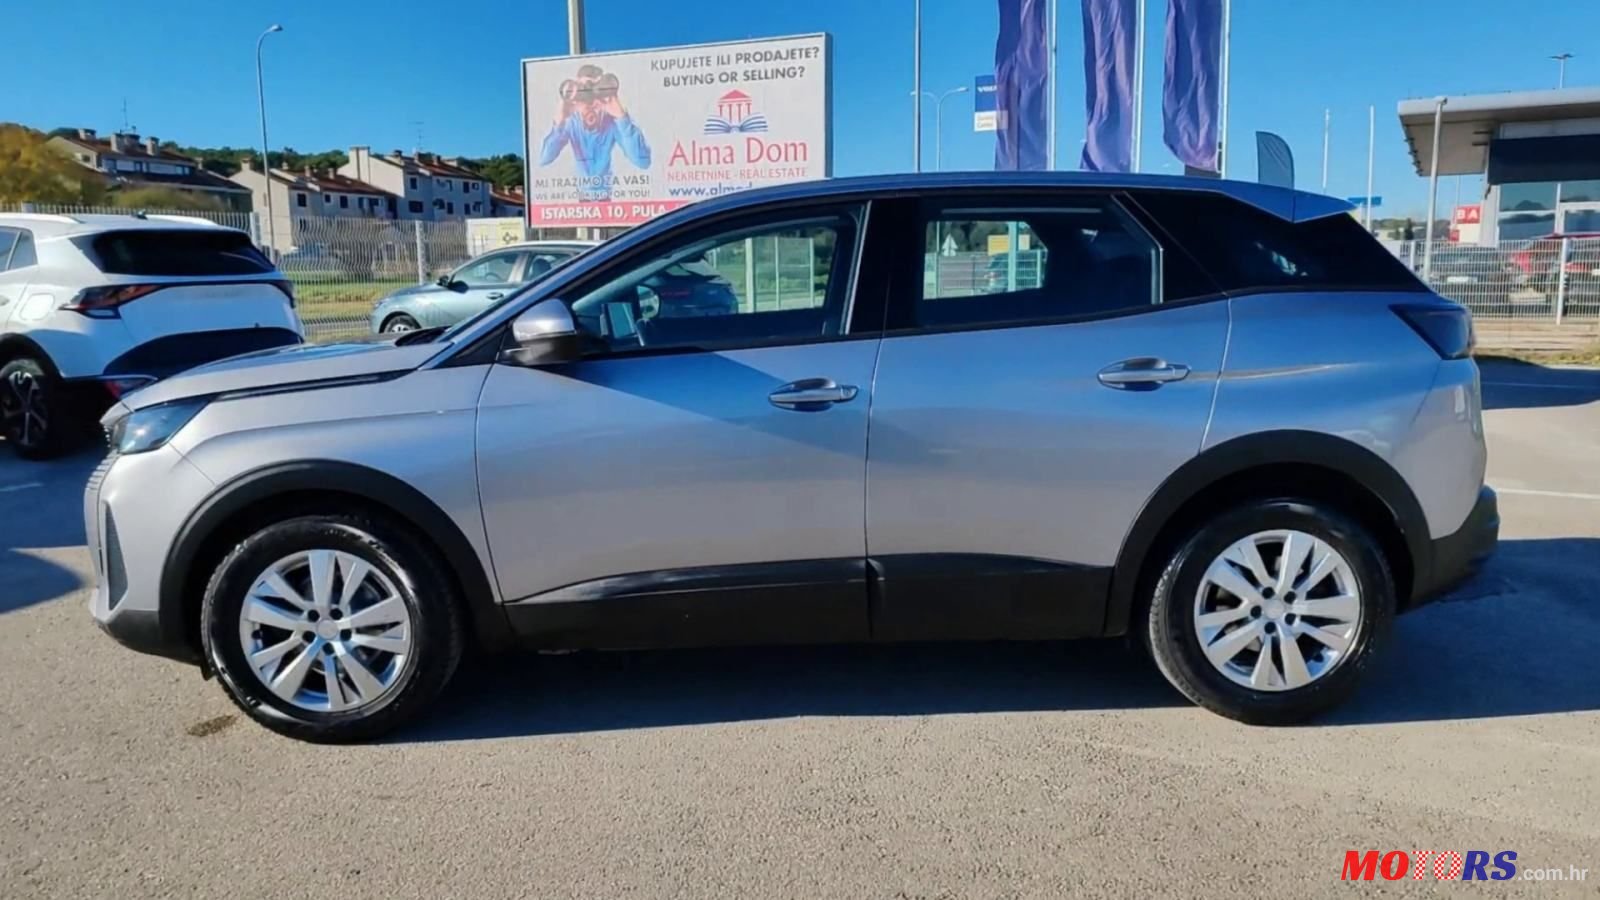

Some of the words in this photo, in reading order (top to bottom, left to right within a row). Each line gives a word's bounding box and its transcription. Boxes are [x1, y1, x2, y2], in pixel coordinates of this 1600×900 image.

[651, 56, 712, 71] KUPUJETE
[717, 54, 731, 66] ILI
[735, 46, 820, 65] PRODAJETE?
[663, 73, 715, 87] BUYING
[718, 71, 738, 83] OR
[743, 66, 805, 81] SELLING?
[668, 140, 735, 166] Alma
[746, 137, 808, 163] Dom
[535, 179, 549, 188] MI
[606, 175, 620, 186] ZA
[623, 175, 649, 185] VAS!
[667, 170, 731, 182] NEKRETNINE
[739, 168, 765, 179] REAL
[768, 167, 808, 178] ESTATE
[628, 189, 650, 198] YOU!
[541, 206, 602, 220] ISTARSKA
[607, 206, 628, 219] 10,
[632, 204, 666, 217] PULA
